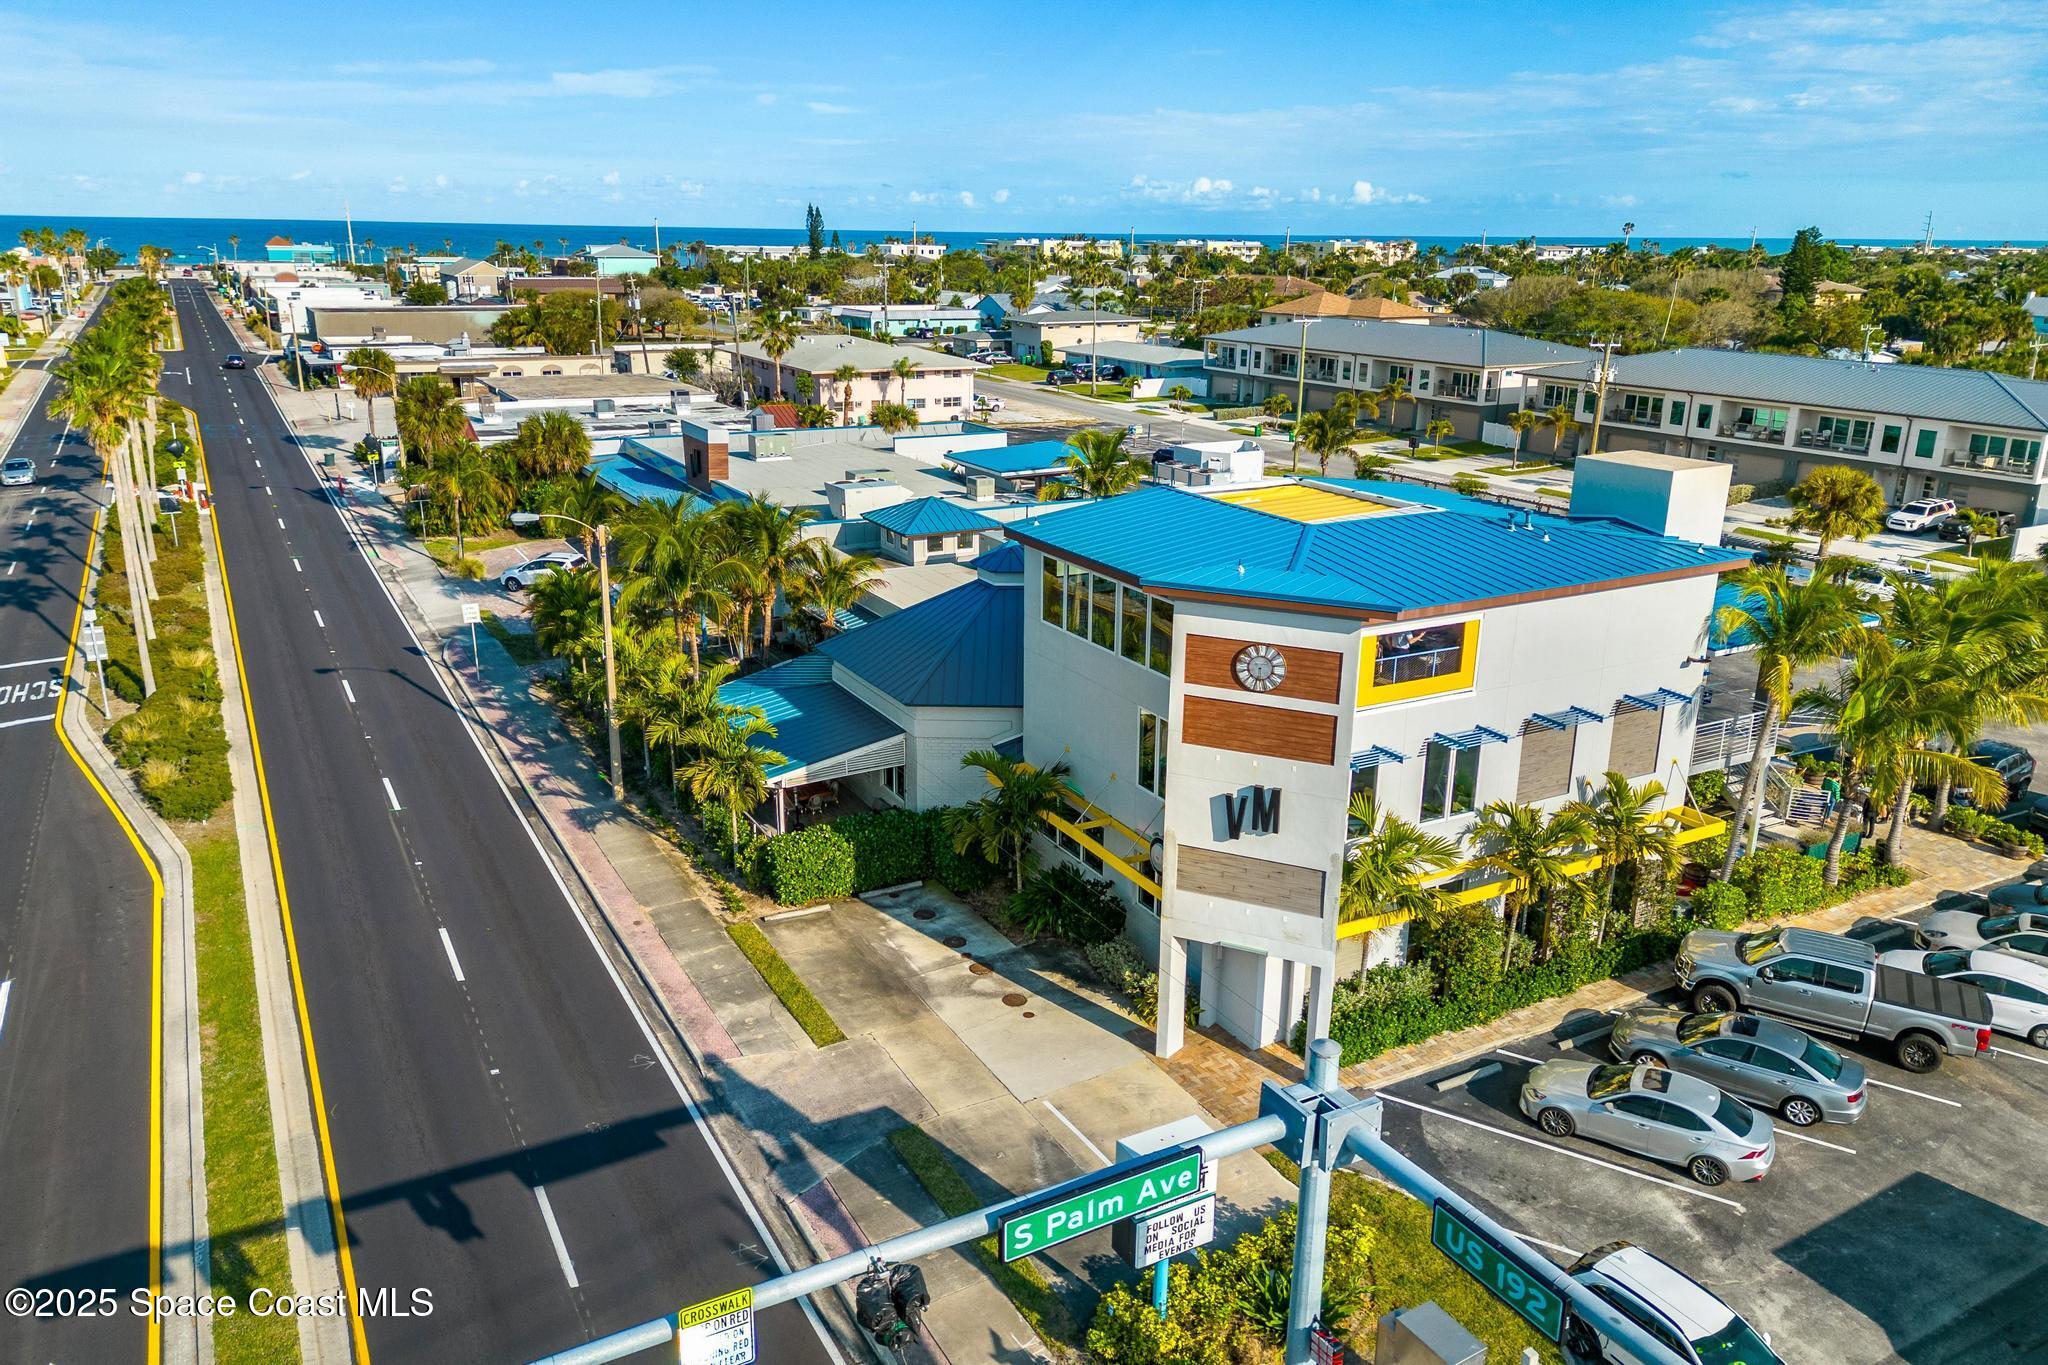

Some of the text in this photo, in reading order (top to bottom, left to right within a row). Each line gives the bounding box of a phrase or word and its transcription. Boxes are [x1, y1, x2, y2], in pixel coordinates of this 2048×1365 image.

[1225, 784, 1282, 840] VM
[1014, 1223, 1033, 1250] S
[1046, 1194, 1124, 1239] Palm
[1136, 1169, 1193, 1206] Ave
[1146, 1204, 1206, 1234] FOLLOW US
[1144, 1229, 1197, 1256] MEDIA FOR
[1146, 1216, 1206, 1244] ON SOCIAL
[1158, 1239, 1194, 1260] EVENTS
[1446, 1222, 1546, 1322] US 192
[683, 1294, 749, 1326] CROSSWALK
[713, 1316, 727, 1331] ON
[729, 1309, 749, 1326] RED
[733, 1327, 744, 1339] ON
[733, 1337, 749, 1351] RED
